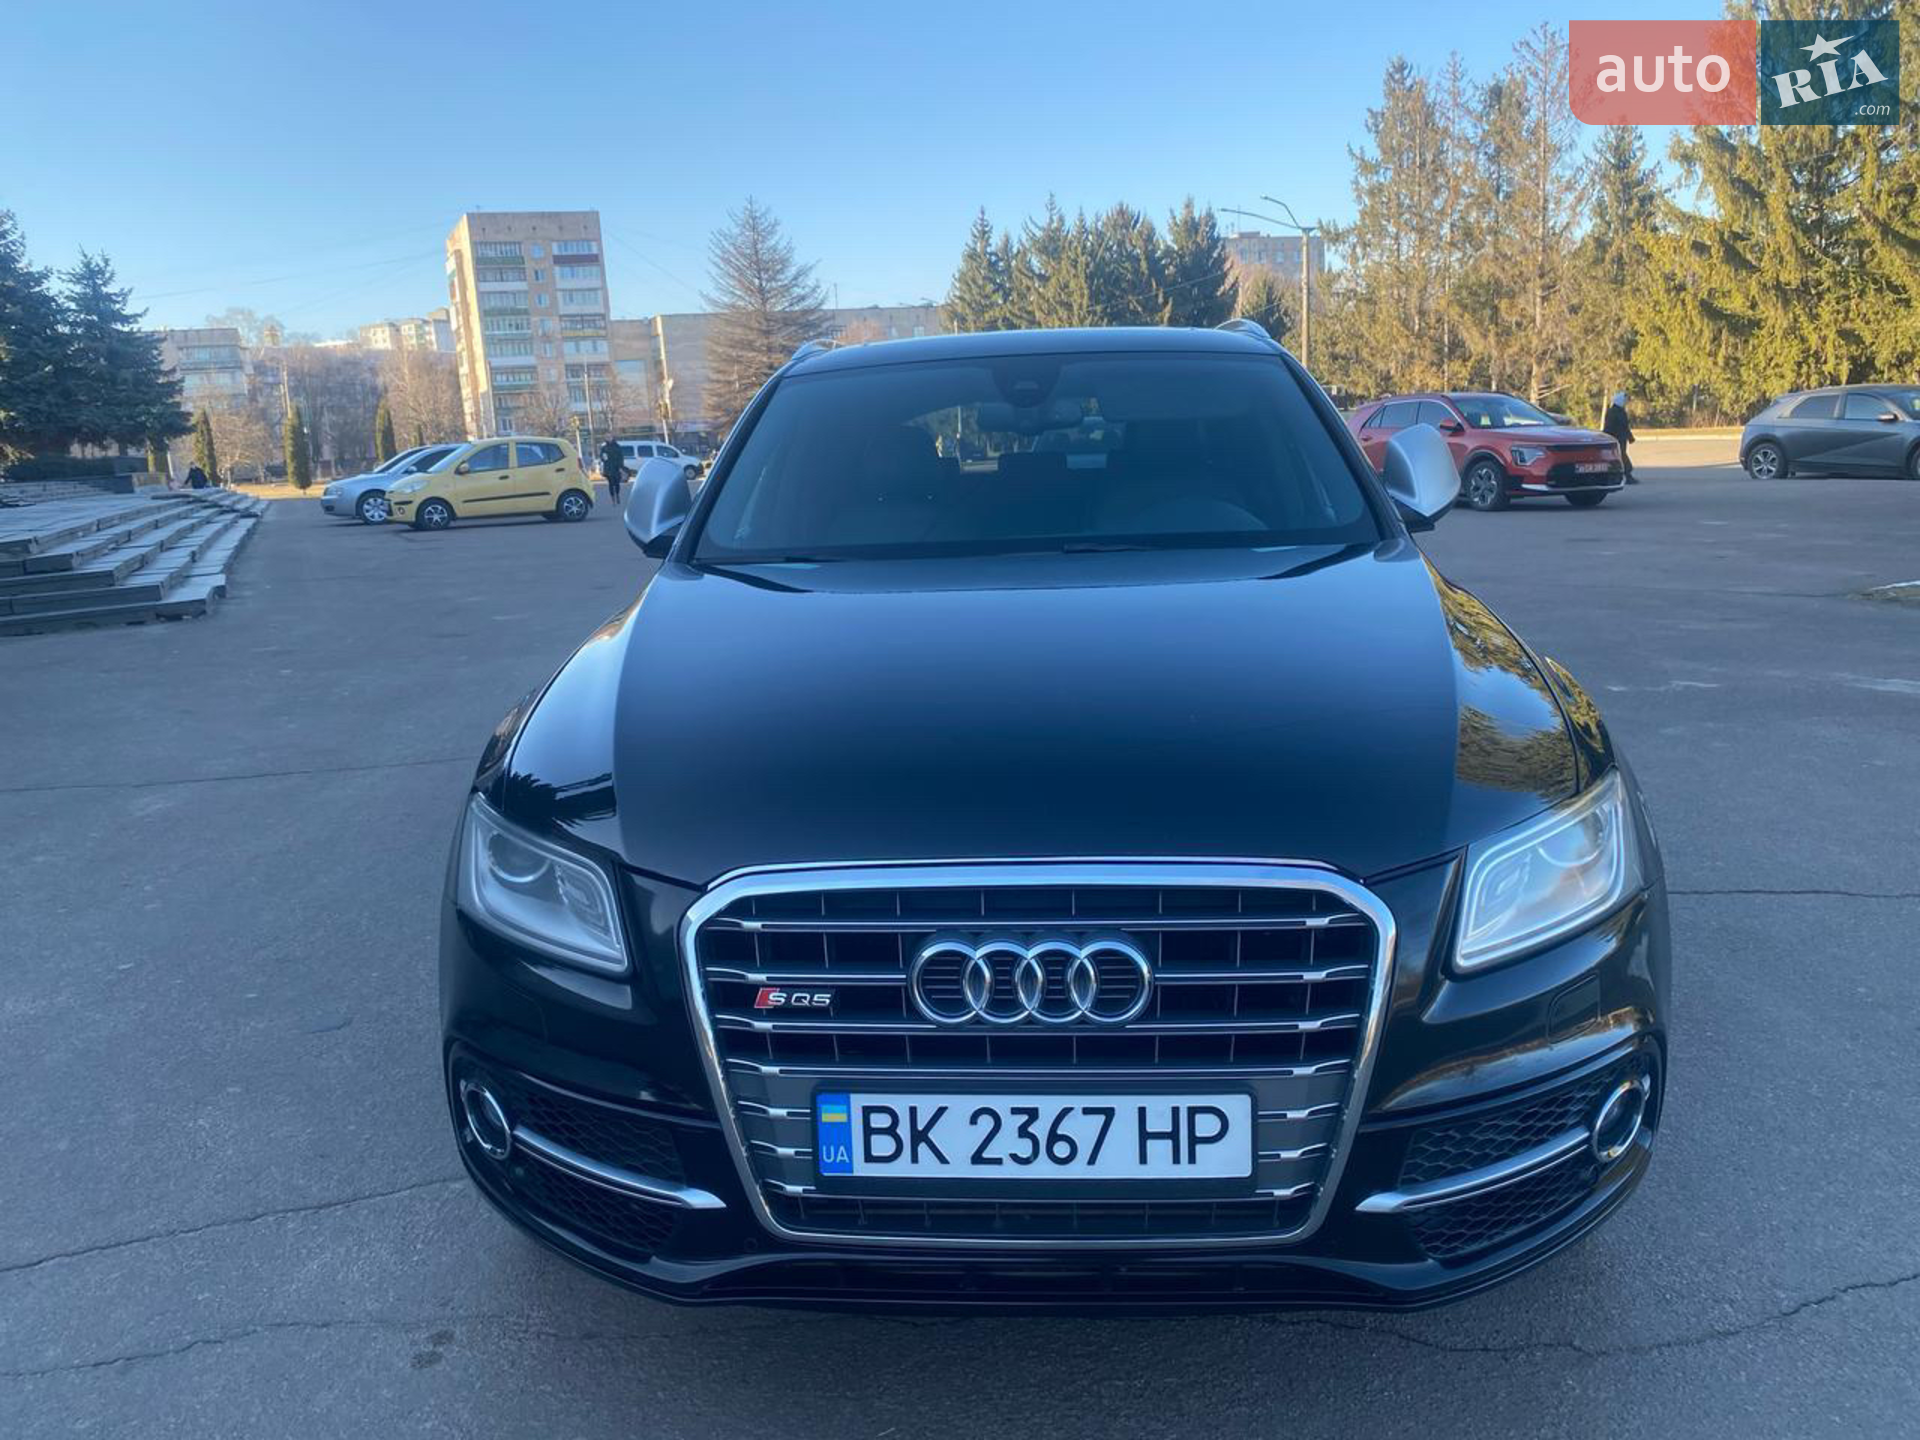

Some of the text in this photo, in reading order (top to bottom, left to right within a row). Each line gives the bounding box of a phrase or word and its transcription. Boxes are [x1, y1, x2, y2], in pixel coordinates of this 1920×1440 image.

[822, 1145, 850, 1163] UA
[861, 1105, 1230, 1166] BK 2367 HP
